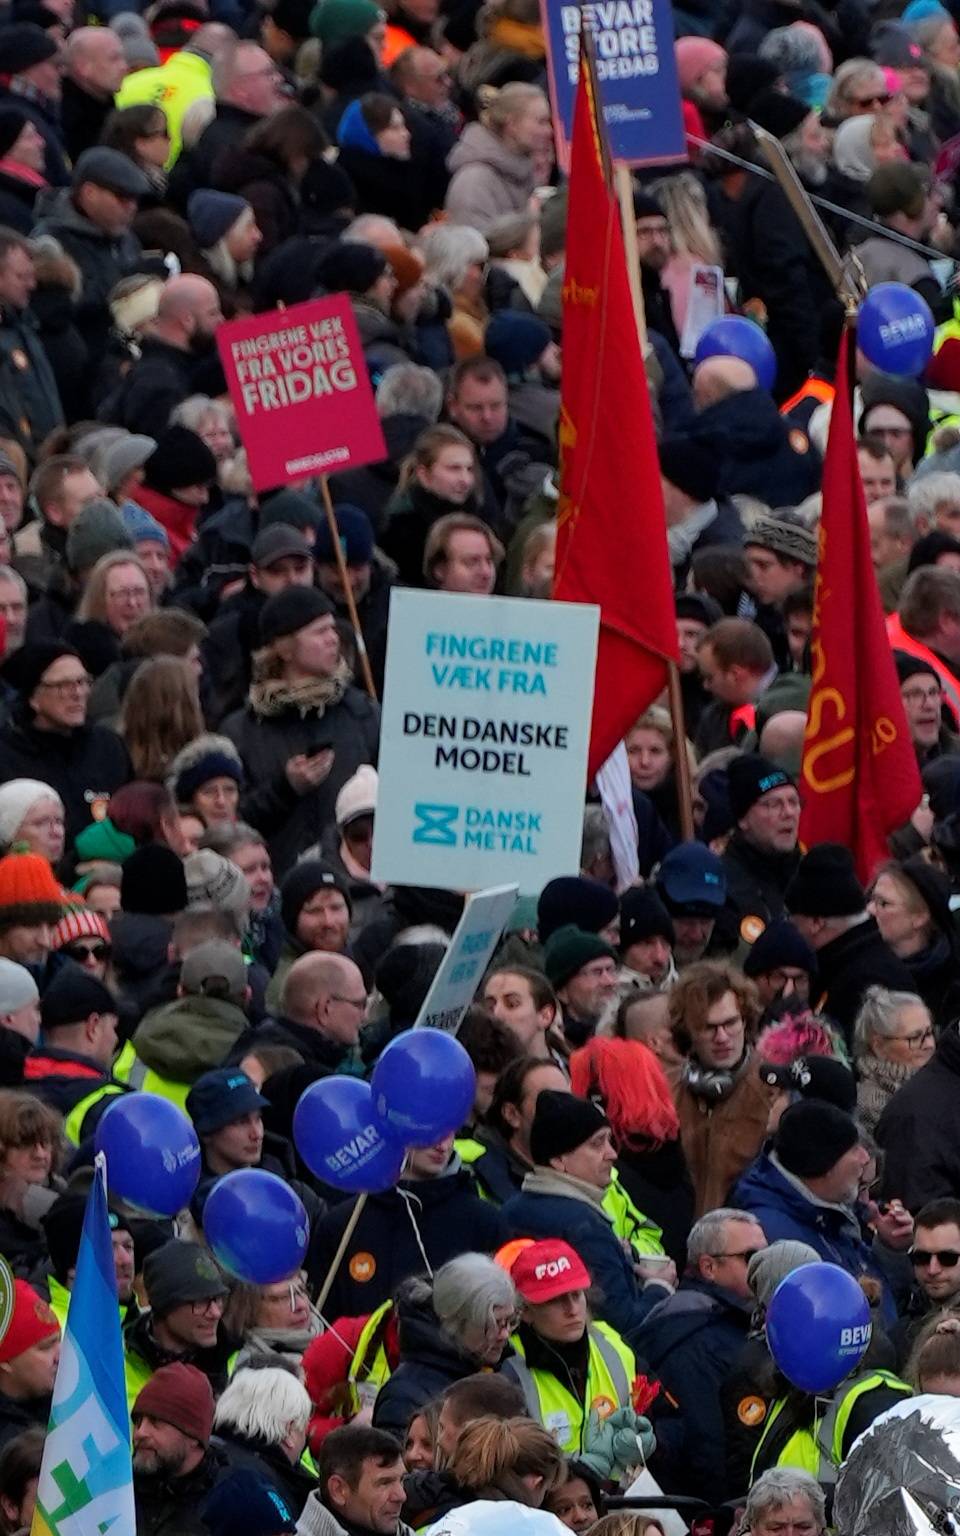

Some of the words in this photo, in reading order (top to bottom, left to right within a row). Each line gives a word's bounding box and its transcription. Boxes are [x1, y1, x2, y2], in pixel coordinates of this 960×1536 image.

[231, 325, 307, 361] FINGRENE
[309, 316, 344, 341] VÆK
[236, 353, 277, 384] FRA
[278, 334, 350, 373] VORES
[241, 358, 359, 416] FRIDAG
[425, 632, 559, 667] FINGRENE
[432, 663, 491, 691] VÆK
[497, 669, 548, 696] FRA
[402, 711, 457, 740] DEN
[462, 718, 569, 749] DANSKE
[434, 746, 532, 777] MODEL
[464, 806, 543, 833] DANSK
[463, 831, 539, 856] METAL
[325, 1123, 380, 1173] BEVAR
[534, 1255, 572, 1280] FOA
